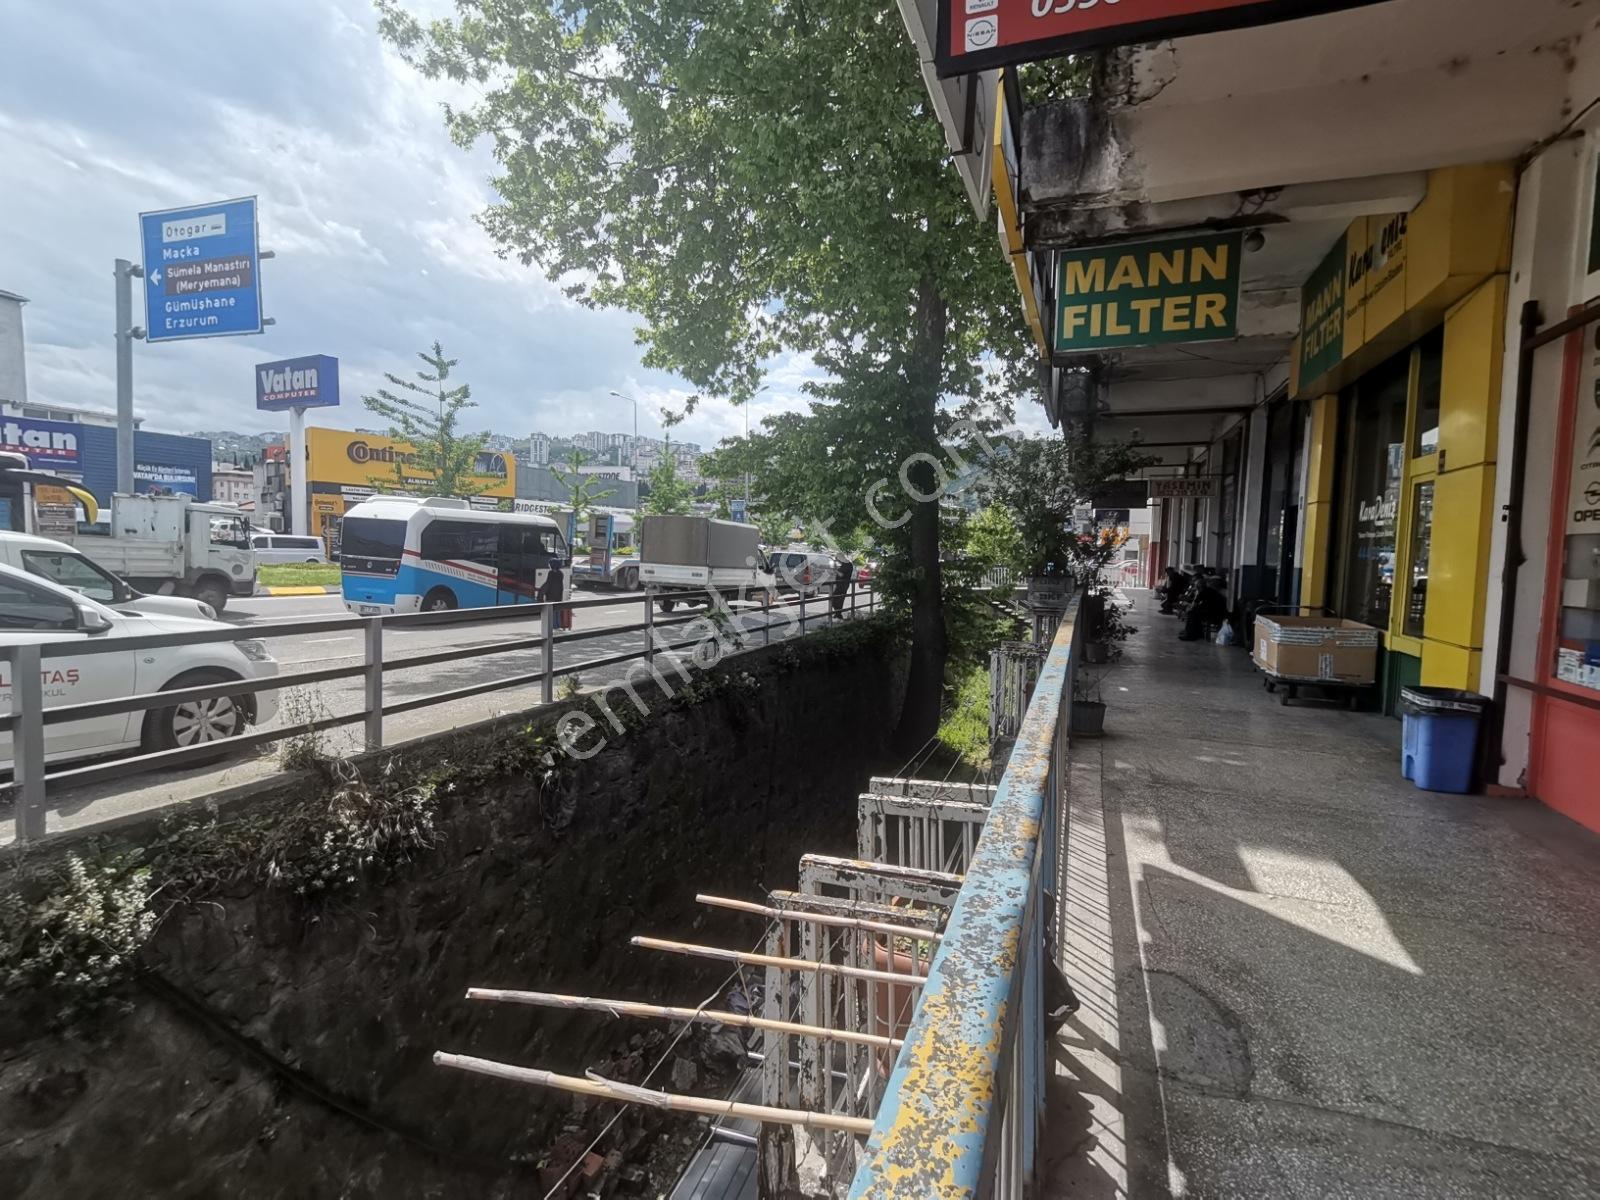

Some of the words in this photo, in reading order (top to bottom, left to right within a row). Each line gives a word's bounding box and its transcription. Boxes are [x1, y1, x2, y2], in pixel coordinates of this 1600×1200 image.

[969, 1, 994, 10] RENAULT
[967, 29, 996, 38] NISSAN
[166, 224, 207, 238] Otogar
[162, 245, 200, 260] Maçka
[167, 264, 202, 278] Sümela
[204, 260, 250, 274] Manastırı
[1065, 244, 1228, 295] MANN
[176, 275, 241, 294] (Meryemana)
[165, 297, 236, 312] Gümüşhane
[1305, 269, 1342, 331] MANN
[166, 315, 218, 329] Erzurum
[1063, 293, 1227, 339] FILTER
[1304, 307, 1342, 364] FILTER
[261, 366, 318, 394] Vatan
[264, 390, 316, 400] COMPUTER
[0, 424, 78, 450] tan
